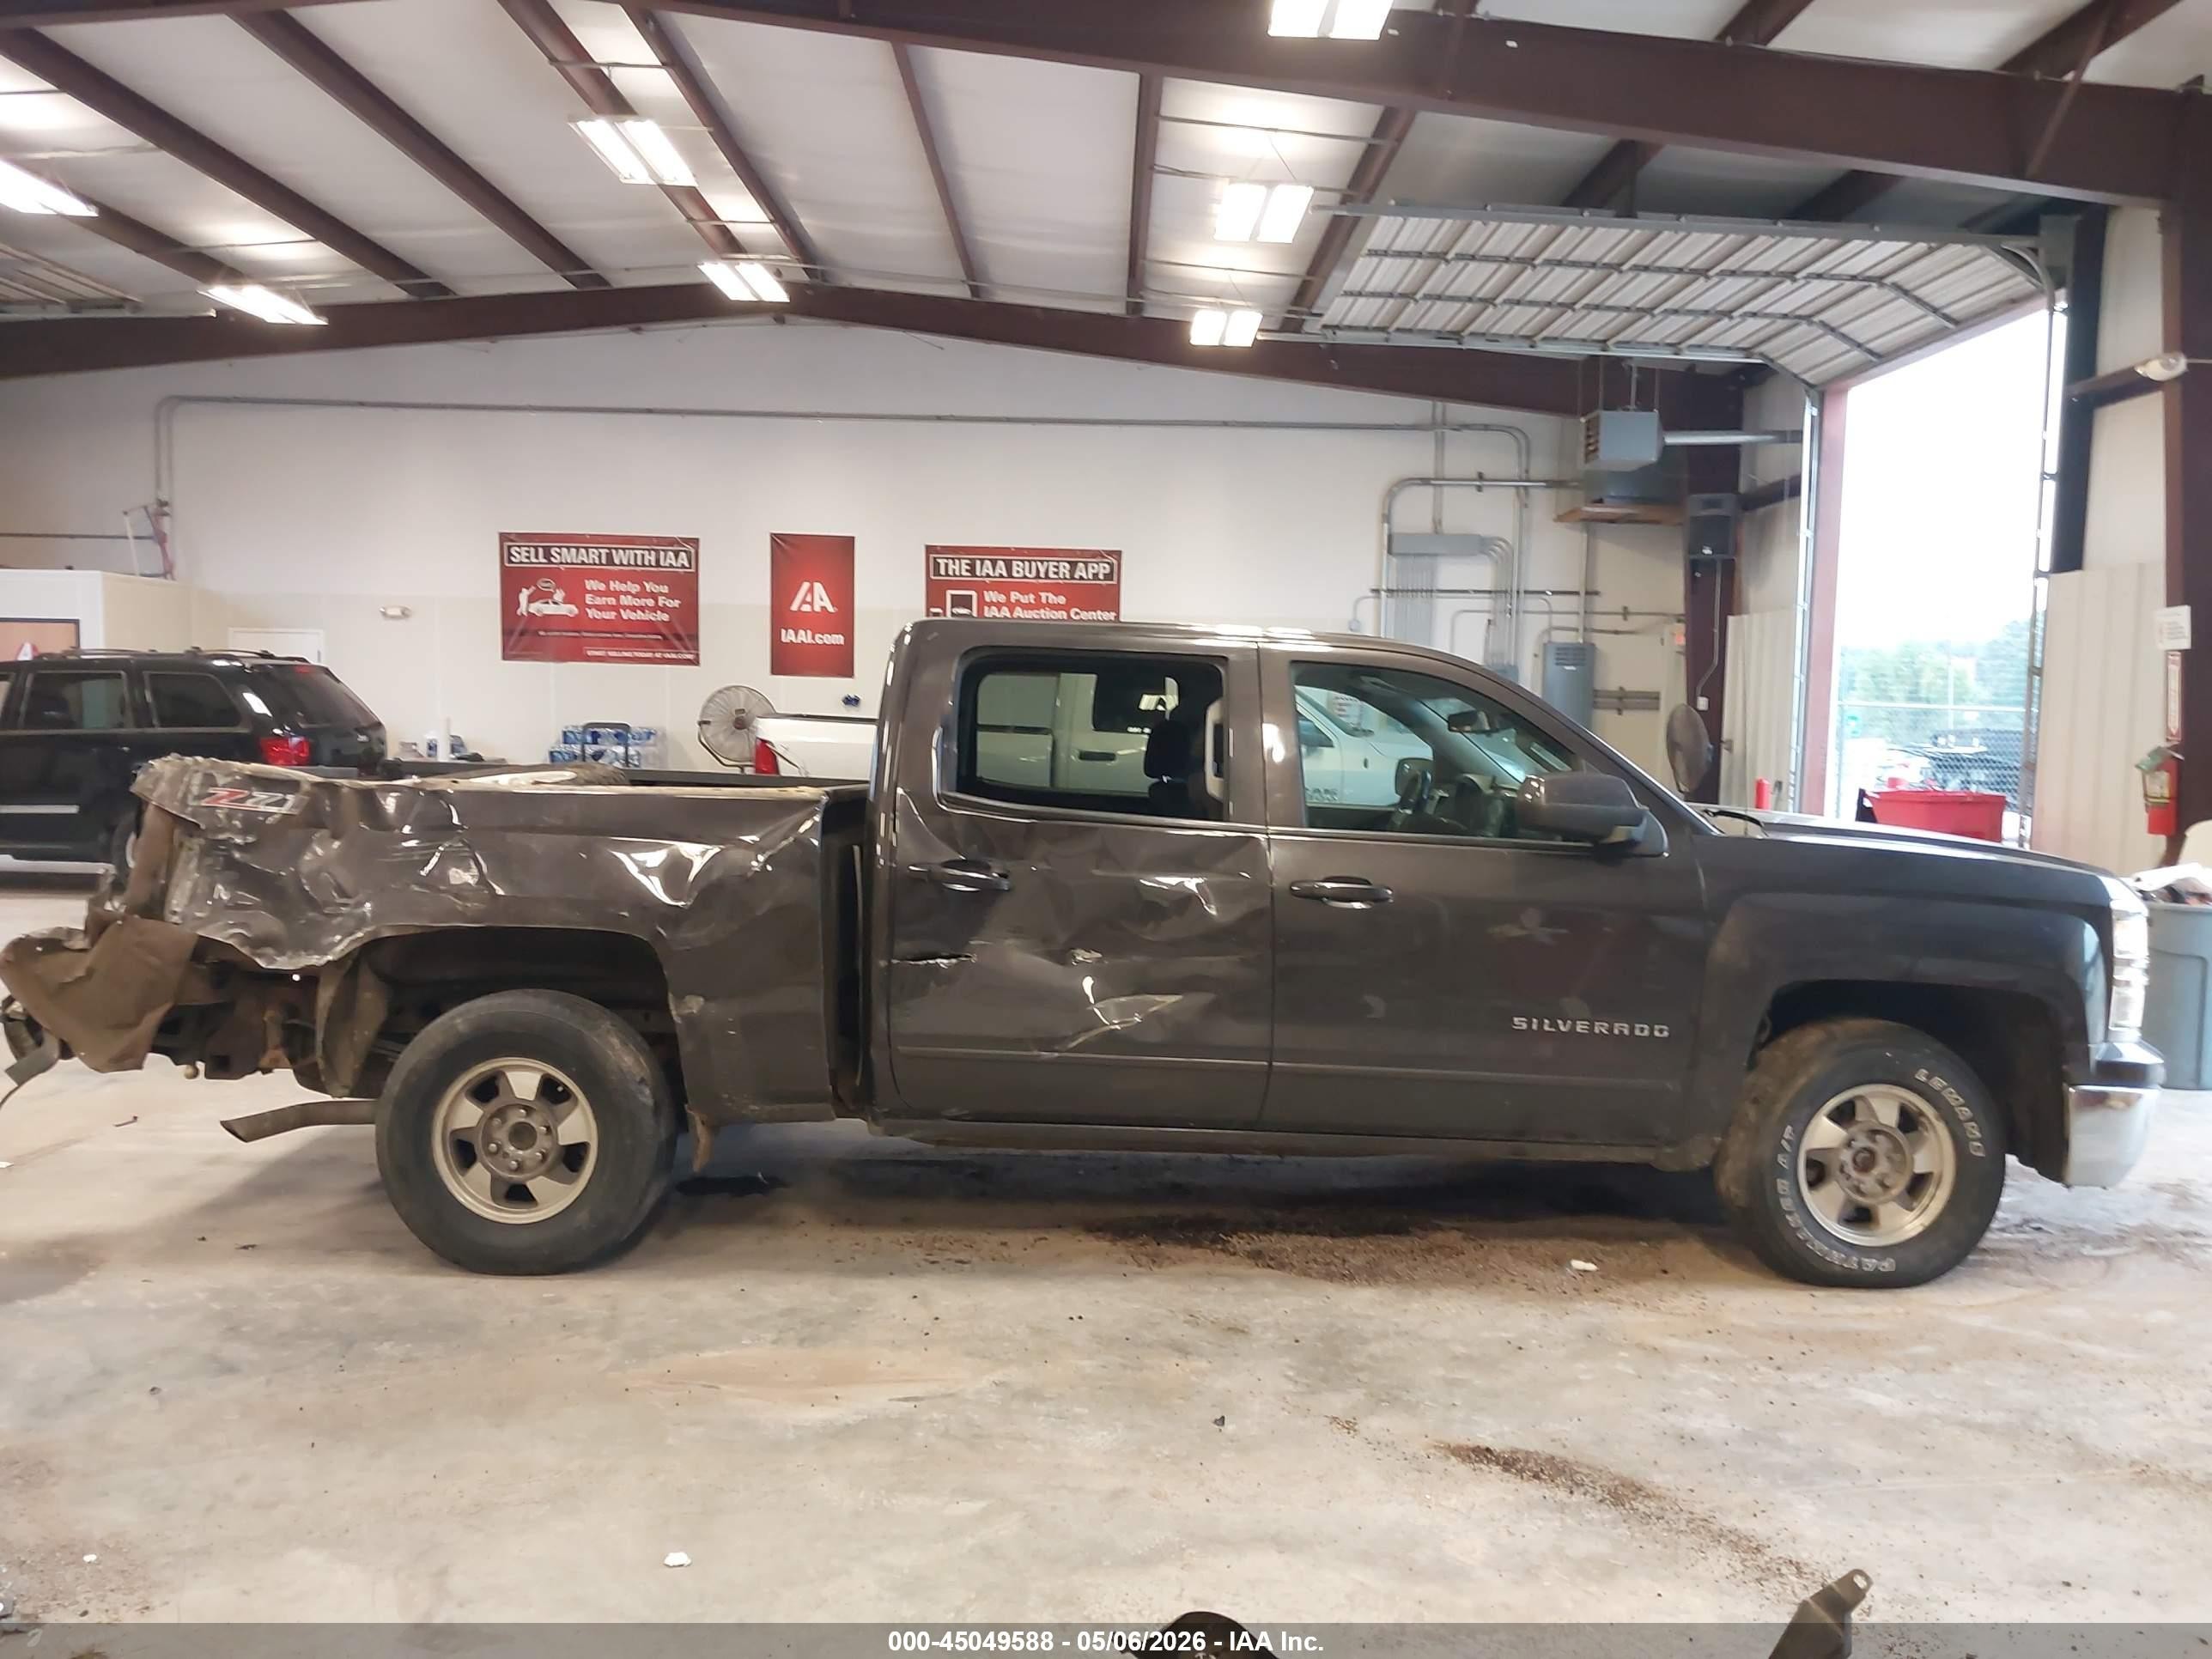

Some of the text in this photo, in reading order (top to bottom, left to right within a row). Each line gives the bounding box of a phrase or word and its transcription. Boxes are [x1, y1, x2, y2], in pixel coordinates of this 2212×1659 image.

[509, 546, 690, 568] SELL SMART WITH IAA
[936, 558, 1110, 580] THE IAA BUYER APP
[584, 579, 669, 593] We Help You
[585, 594, 681, 608] Earn More For
[983, 591, 1067, 605] We Put The
[585, 608, 670, 622] Your Vehicle
[983, 606, 1116, 621] IAA Auction Center
[781, 628, 845, 645] IAAI.com
[1511, 1017, 1670, 1037] SILVERADO
